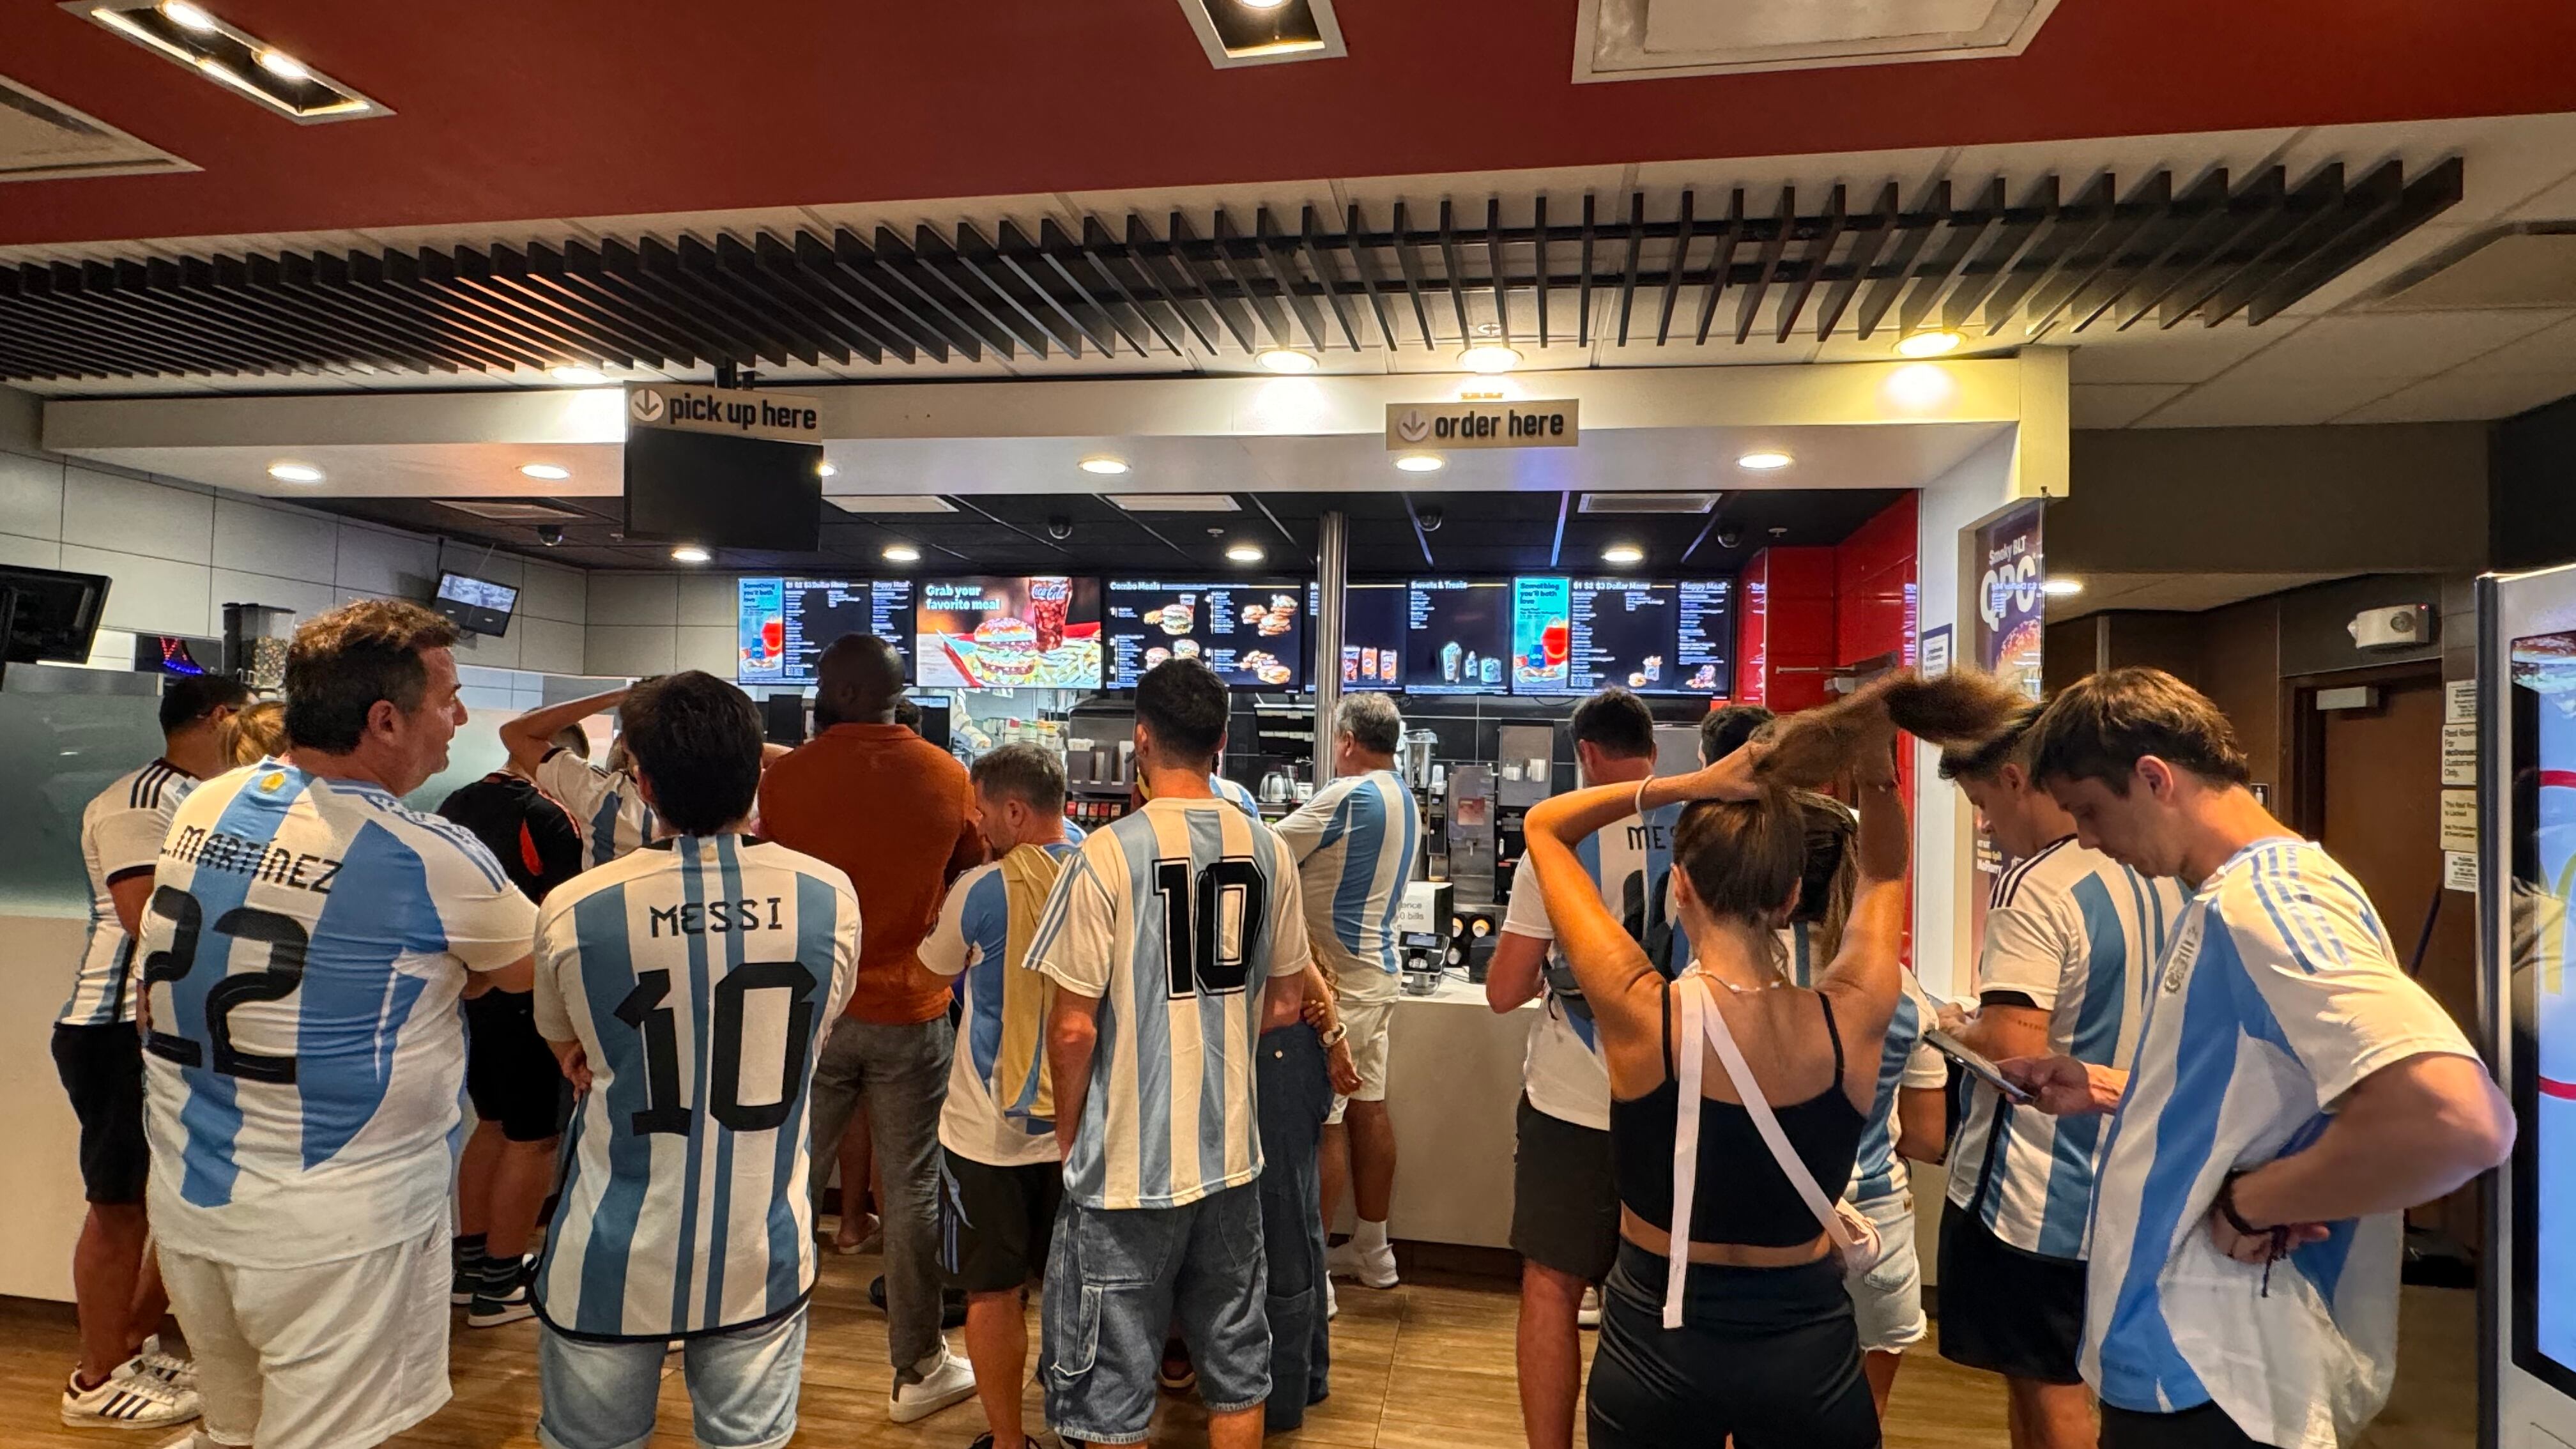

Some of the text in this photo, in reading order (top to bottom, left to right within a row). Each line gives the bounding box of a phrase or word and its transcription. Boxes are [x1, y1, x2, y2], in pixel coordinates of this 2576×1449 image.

[670, 393, 817, 431] pick up here
[1435, 409, 1564, 439] order here
[1989, 535, 2027, 565] Smoky BLT
[926, 584, 981, 599] Grab your
[1109, 581, 1137, 590] Combo
[1137, 581, 1160, 590] Meals
[1438, 579, 1444, 589] &
[1520, 583, 1560, 591] Something
[1583, 581, 1594, 590] $2
[1606, 581, 1629, 590] Dollar
[926, 599, 1000, 610] favorite meal
[649, 896, 783, 939] MESSI
[1151, 855, 1268, 1000] 10
[144, 884, 309, 1085] 22
[613, 961, 818, 1137] 10
